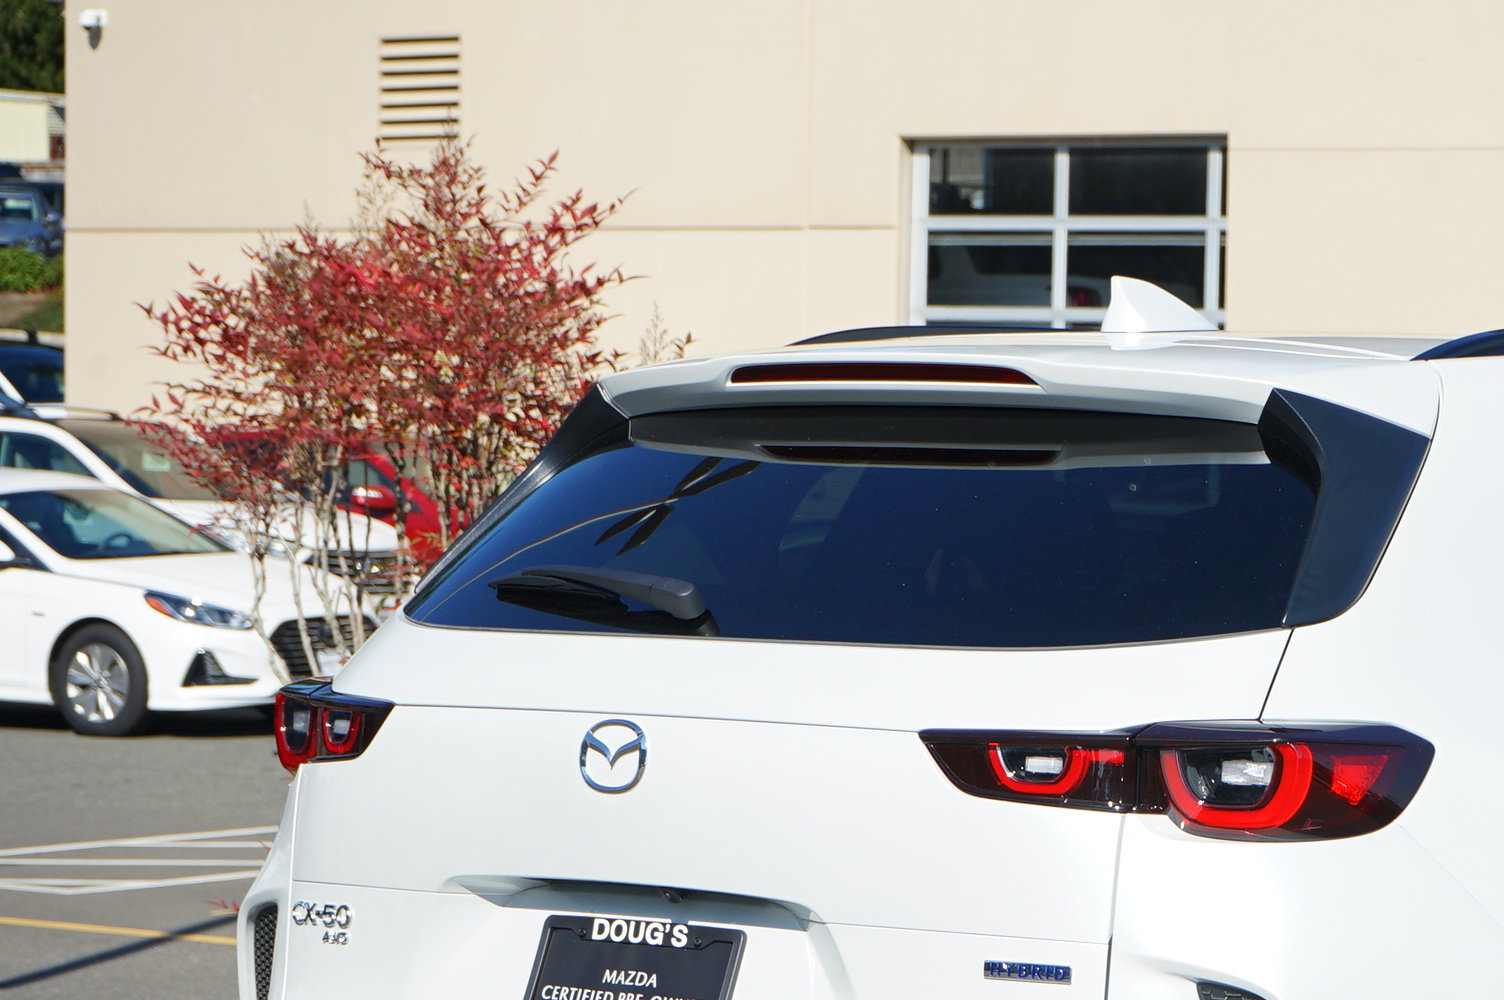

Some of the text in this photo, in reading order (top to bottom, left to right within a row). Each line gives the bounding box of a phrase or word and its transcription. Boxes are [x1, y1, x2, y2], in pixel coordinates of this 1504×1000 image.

[292, 901, 352, 929] CX-50
[591, 918, 688, 948] DOUG'S
[602, 969, 657, 988] MAZDA
[989, 961, 1066, 981] HYBRID
